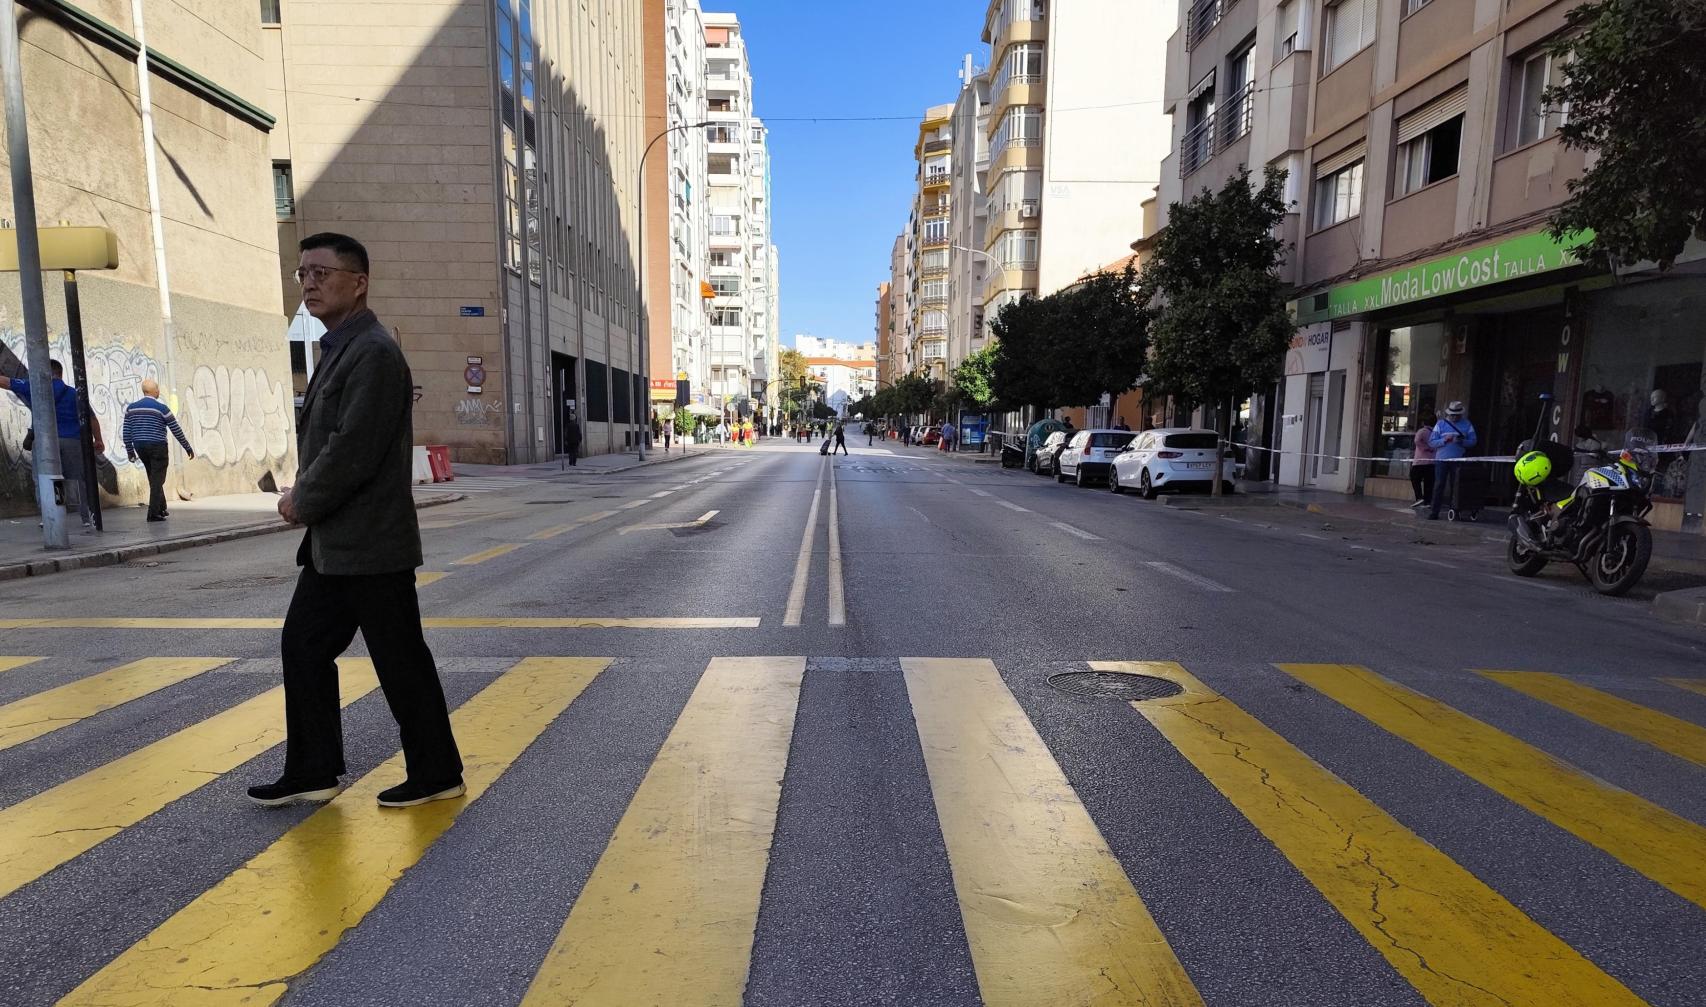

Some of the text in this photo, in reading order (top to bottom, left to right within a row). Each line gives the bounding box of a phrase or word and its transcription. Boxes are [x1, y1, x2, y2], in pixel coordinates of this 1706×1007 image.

[1333, 300, 1358, 316] TALLA
[1364, 295, 1381, 309] XXL
[1503, 254, 1546, 278] TALLA
[1308, 331, 1329, 346] HOGAR
